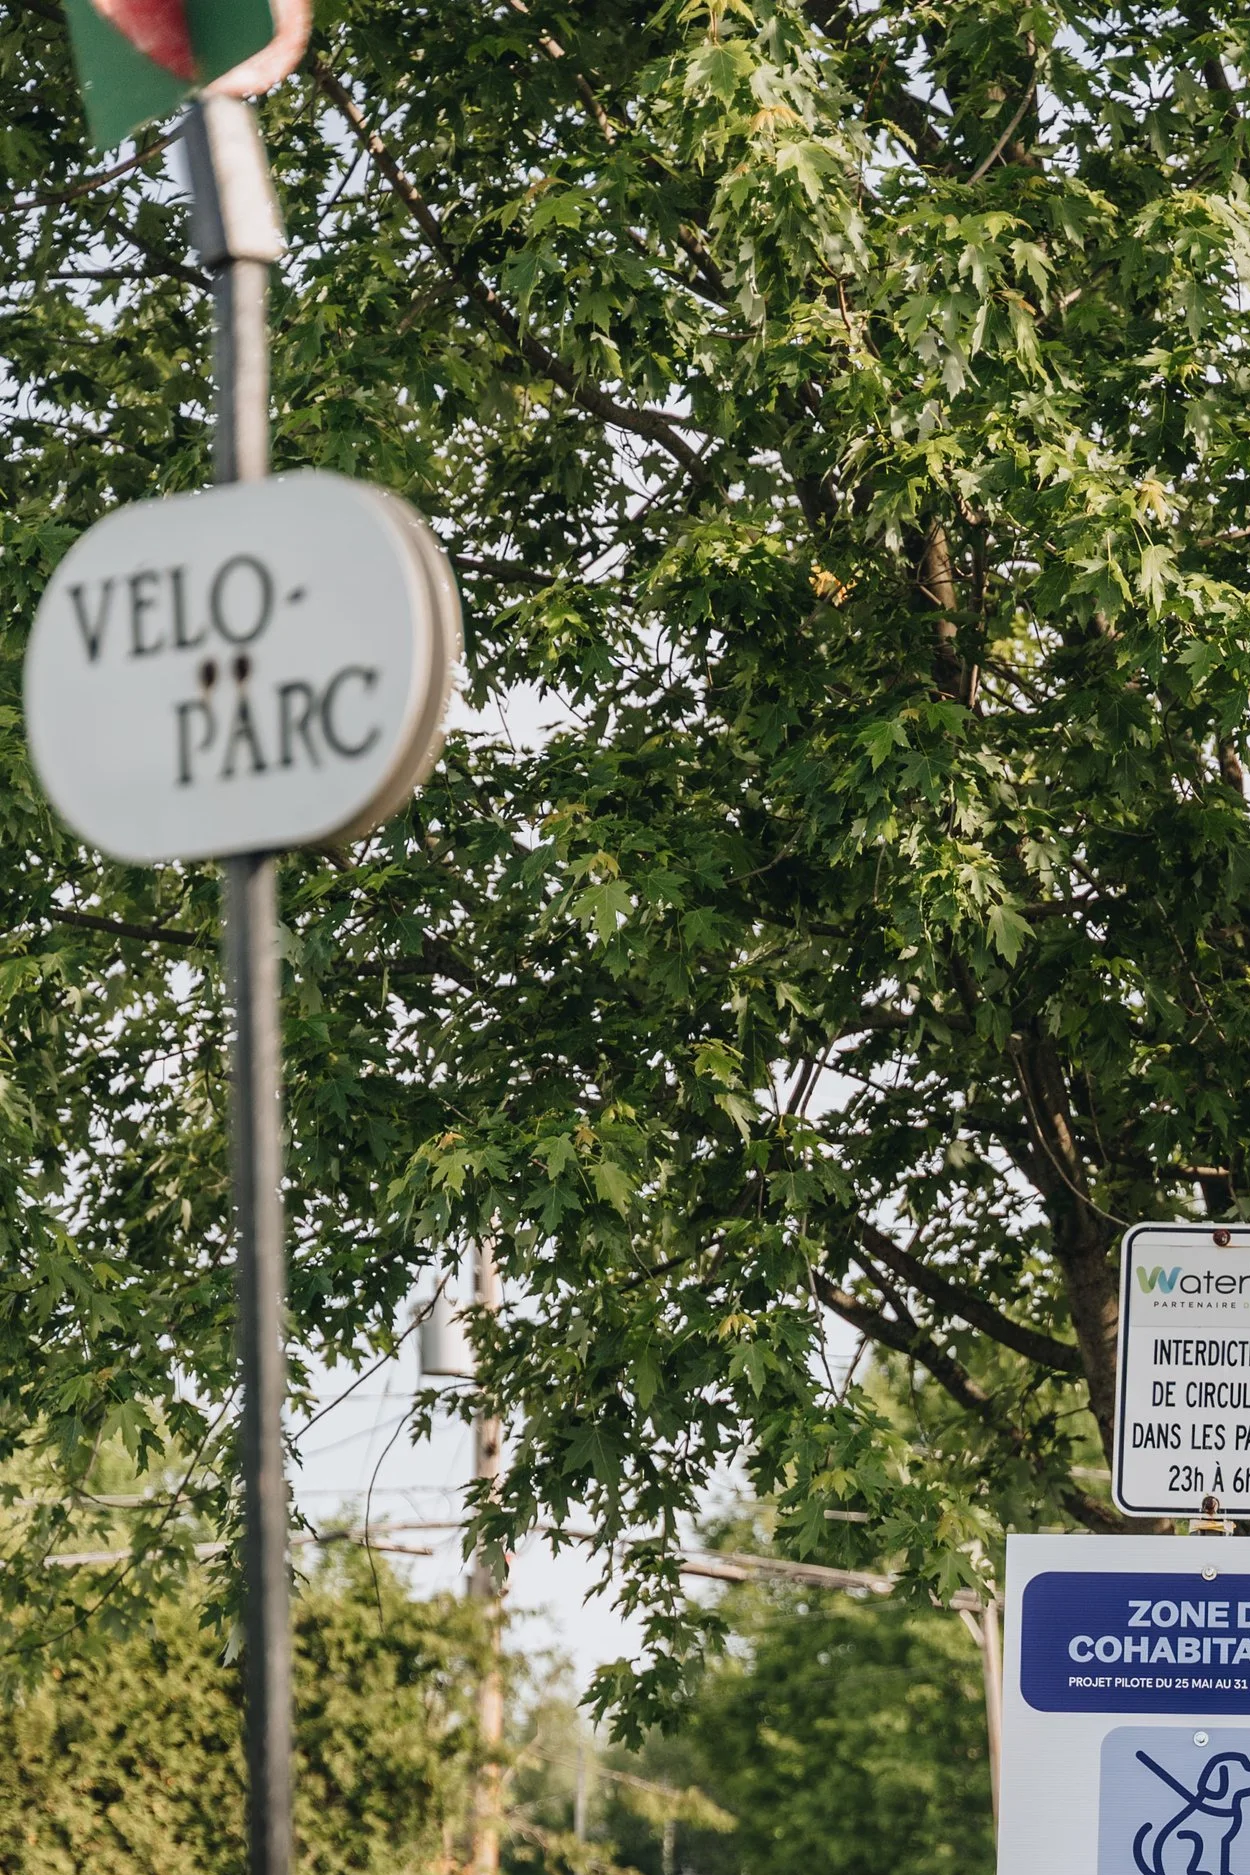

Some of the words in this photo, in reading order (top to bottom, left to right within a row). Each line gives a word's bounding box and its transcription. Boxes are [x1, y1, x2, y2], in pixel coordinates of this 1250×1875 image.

[173, 664, 381, 787] PARC
[1153, 1301, 1237, 1309] PARTENAIRE
[1152, 1381, 1177, 1407] DE
[1132, 1423, 1182, 1449] DANS
[1191, 1424, 1226, 1450] LES
[1168, 1464, 1204, 1492] 23h
[1211, 1461, 1224, 1493] À
[1128, 1600, 1230, 1629] ZONE
[1068, 1676, 1113, 1688] PROJET
[1114, 1677, 1153, 1688] PILOTE
[1155, 1678, 1173, 1688] DU
[1174, 1678, 1189, 1689] 25
[1191, 1679, 1213, 1689] MAI
[1215, 1679, 1232, 1689] AU
[1233, 1679, 1248, 1690] 31
